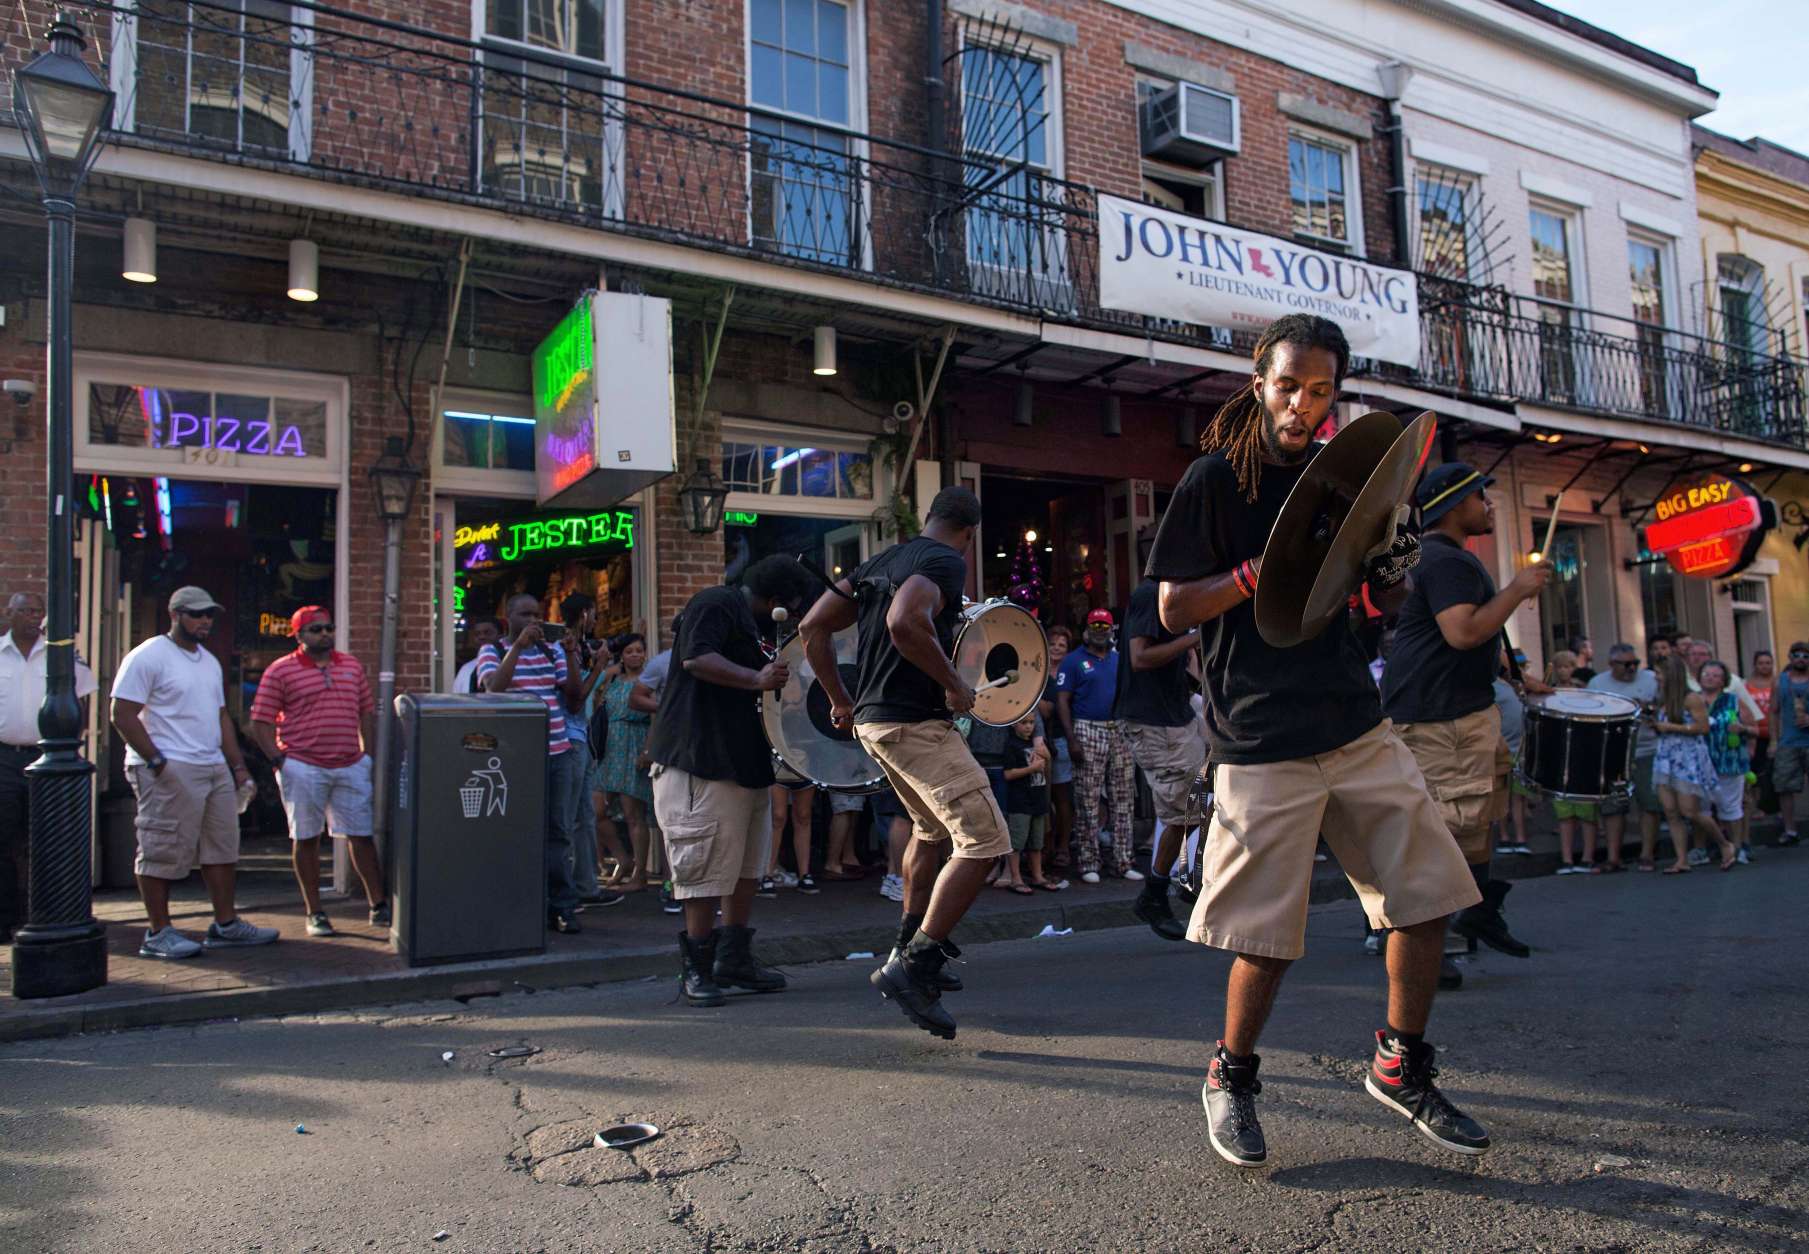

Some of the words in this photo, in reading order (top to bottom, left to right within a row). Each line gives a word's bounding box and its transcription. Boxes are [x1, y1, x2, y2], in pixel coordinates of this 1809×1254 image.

[1115, 210, 1244, 276] JOHN
[1270, 247, 1408, 314] YOUNG
[1189, 270, 1283, 303] LIEUTENANT
[1286, 292, 1361, 321] GOVERNOR
[166, 412, 307, 457] PIZZA
[1655, 492, 1687, 521] BIG
[1687, 480, 1732, 509] EASY
[500, 511, 635, 561] JESTER
[1682, 544, 1724, 568] PIZZA
[1056, 672, 1066, 686] 3
